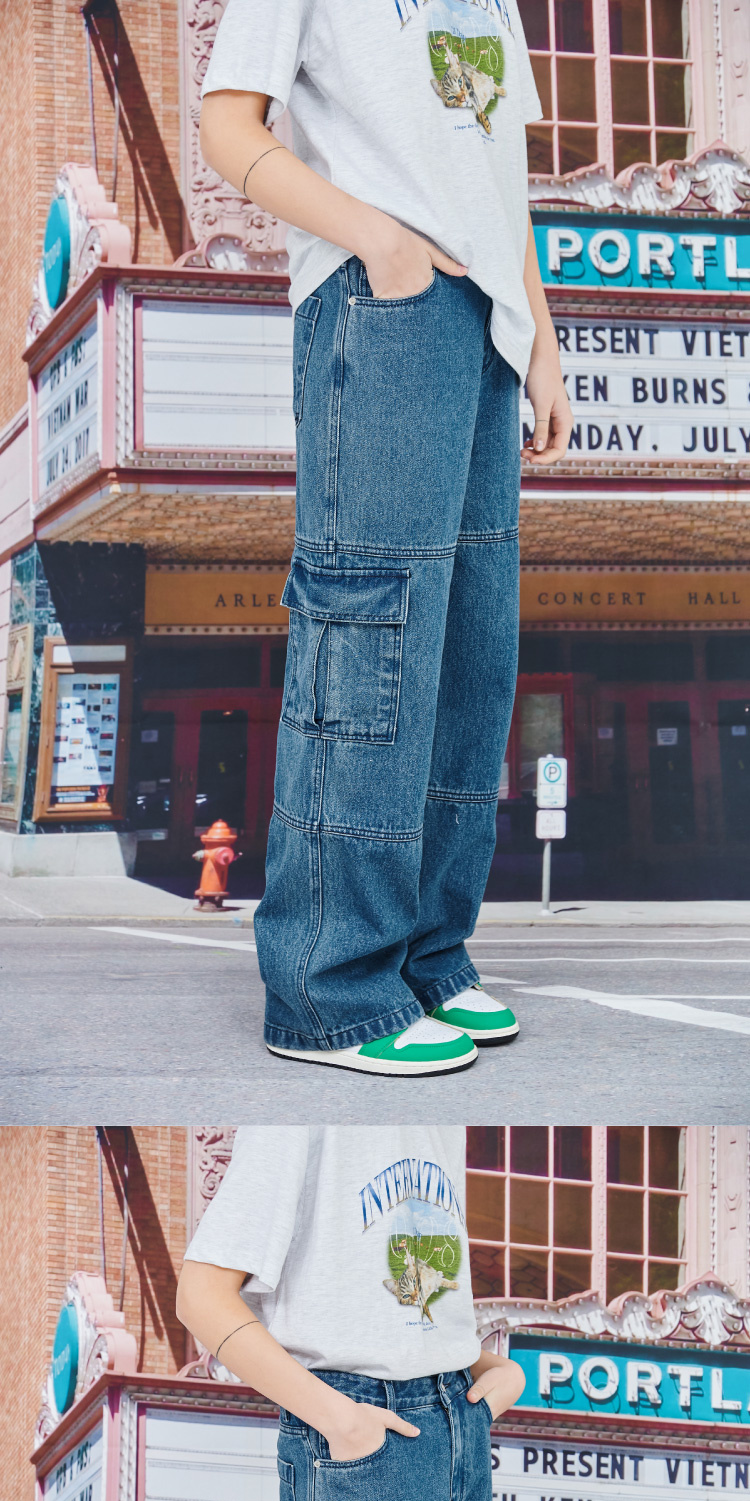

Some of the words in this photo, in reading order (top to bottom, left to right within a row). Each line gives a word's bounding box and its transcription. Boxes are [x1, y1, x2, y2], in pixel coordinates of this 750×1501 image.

[554, 324, 659, 355] RESENT
[681, 329, 750, 357] VIET
[632, 377, 727, 405] BURNS
[215, 593, 277, 607] ARLE
[537, 592, 646, 606] CONCERT
[688, 592, 741, 605] HALL
[538, 1353, 750, 1410] PORTL
[523, 1446, 644, 1481] PRESENT
